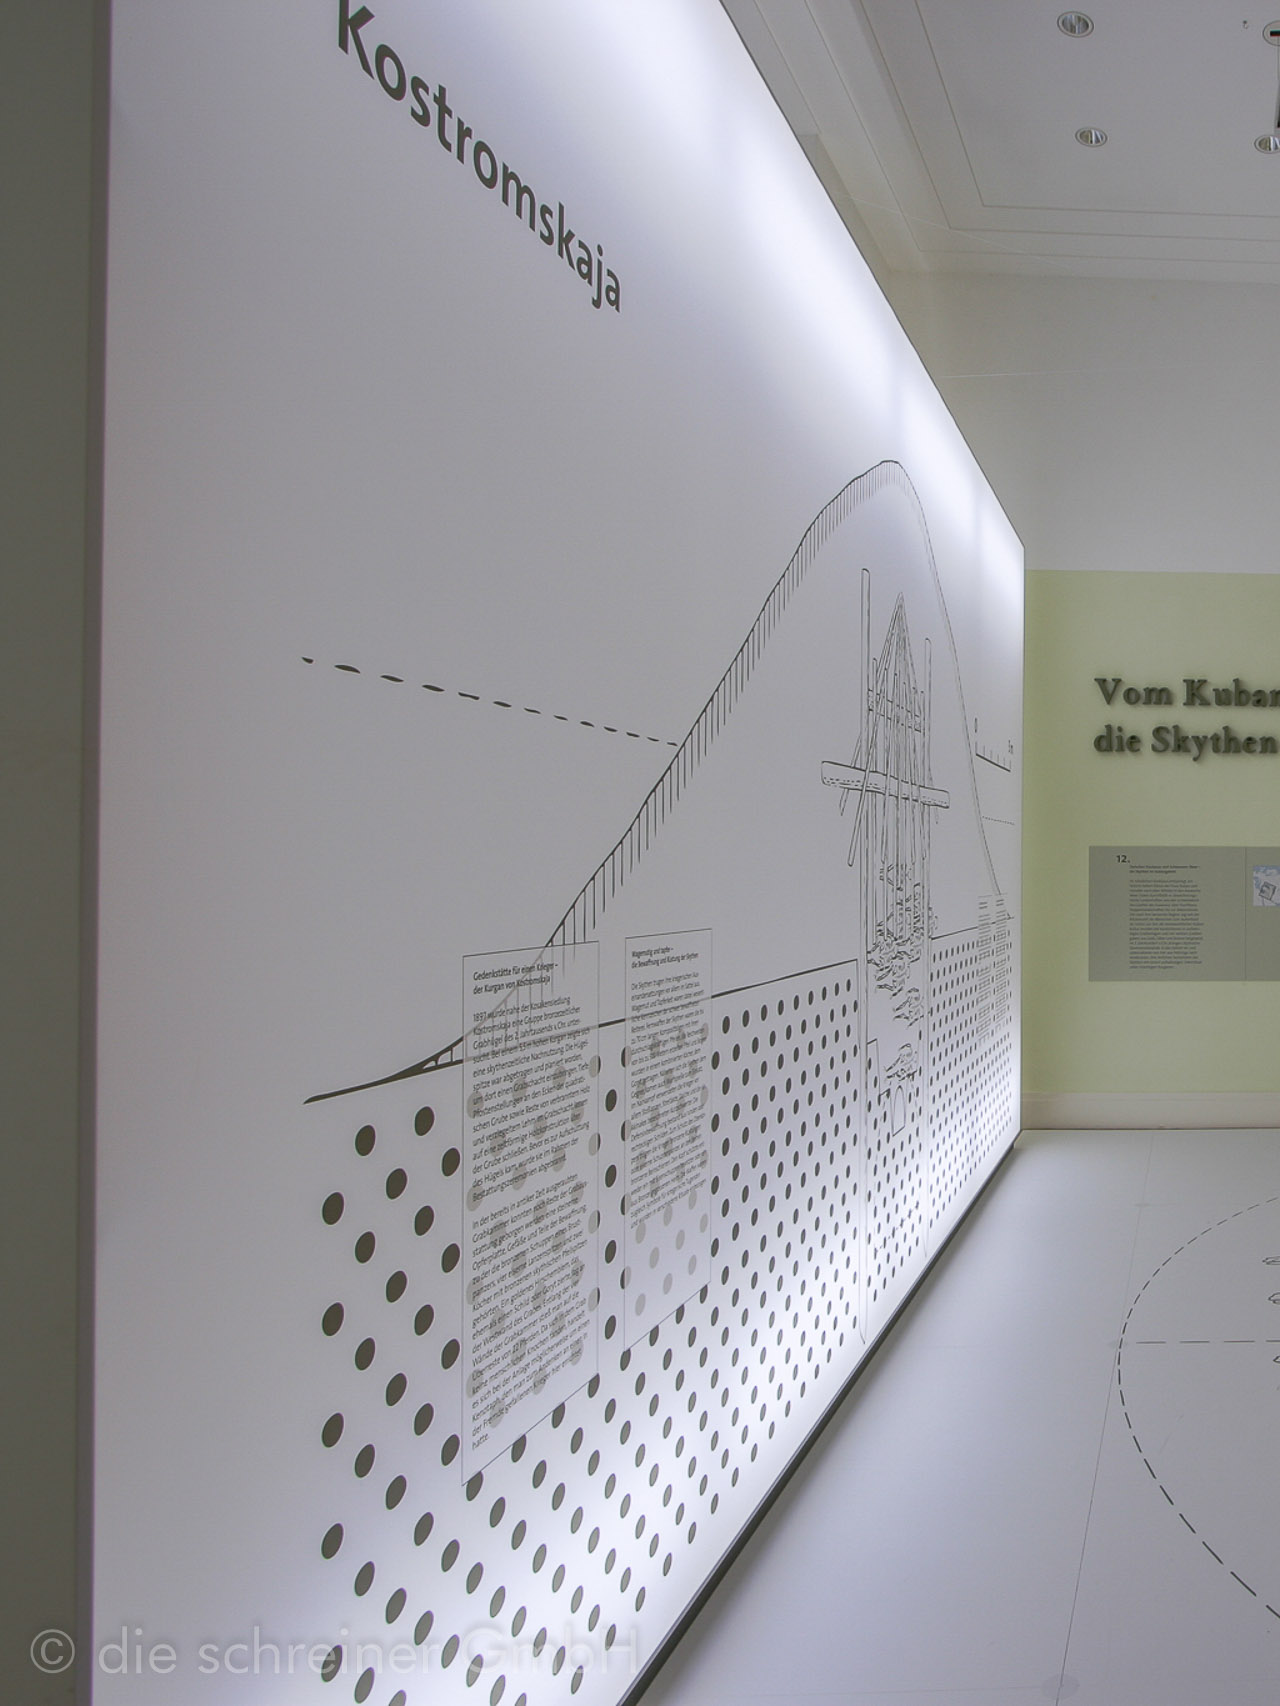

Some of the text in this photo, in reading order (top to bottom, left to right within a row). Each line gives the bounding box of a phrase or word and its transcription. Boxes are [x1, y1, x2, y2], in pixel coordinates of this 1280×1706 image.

[337, 0, 620, 313] Kostromskaja
[1094, 678, 1174, 706] Vom
[1093, 724, 1142, 753] die
[1151, 725, 1278, 763] Skythen
[1116, 855, 1131, 863] 12.
[473, 968, 511, 981] Gedenkstätte
[512, 966, 520, 975] für
[473, 985, 483, 995] der
[484, 983, 504, 994] Kurgan
[505, 981, 515, 989] von
